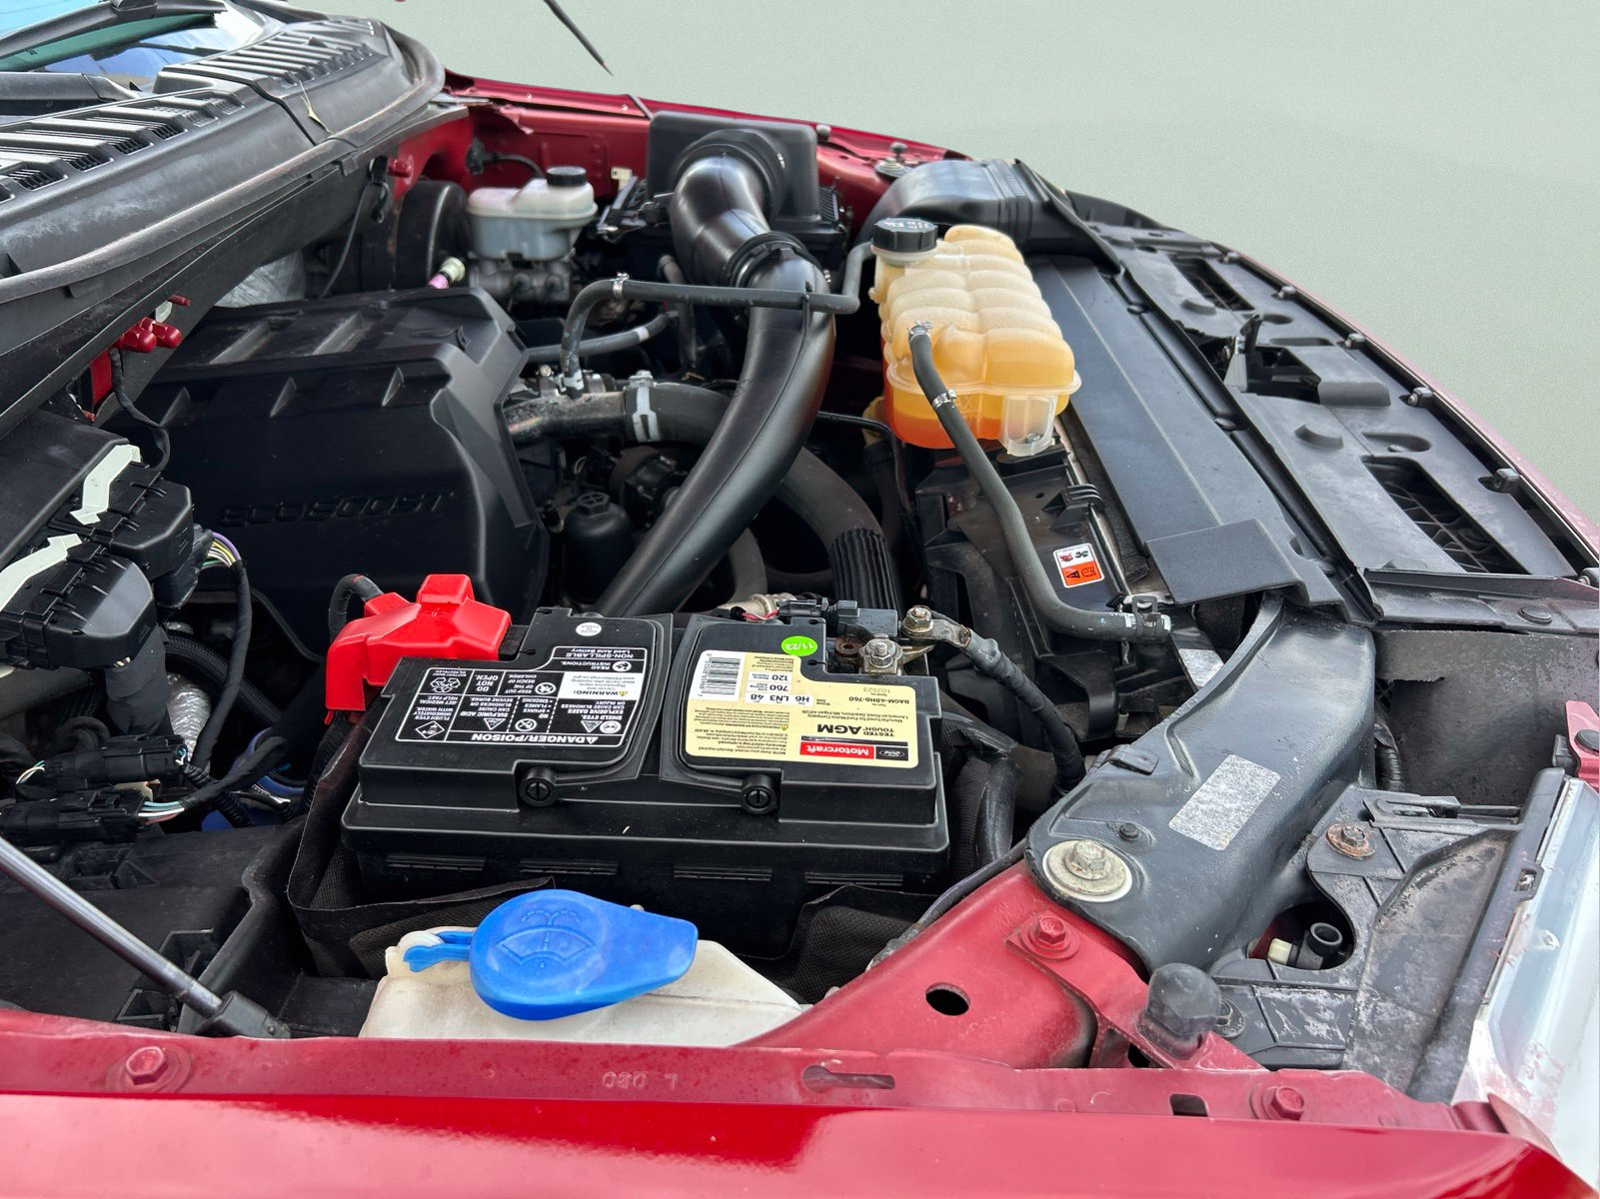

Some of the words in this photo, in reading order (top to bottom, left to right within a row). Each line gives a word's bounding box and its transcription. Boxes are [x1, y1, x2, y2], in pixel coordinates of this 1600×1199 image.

[785, 642, 814, 650] 11/23
[818, 724, 861, 735] AGM
[471, 734, 586, 744] DANGER/POISON
[806, 745, 869, 756] Motorcraft
